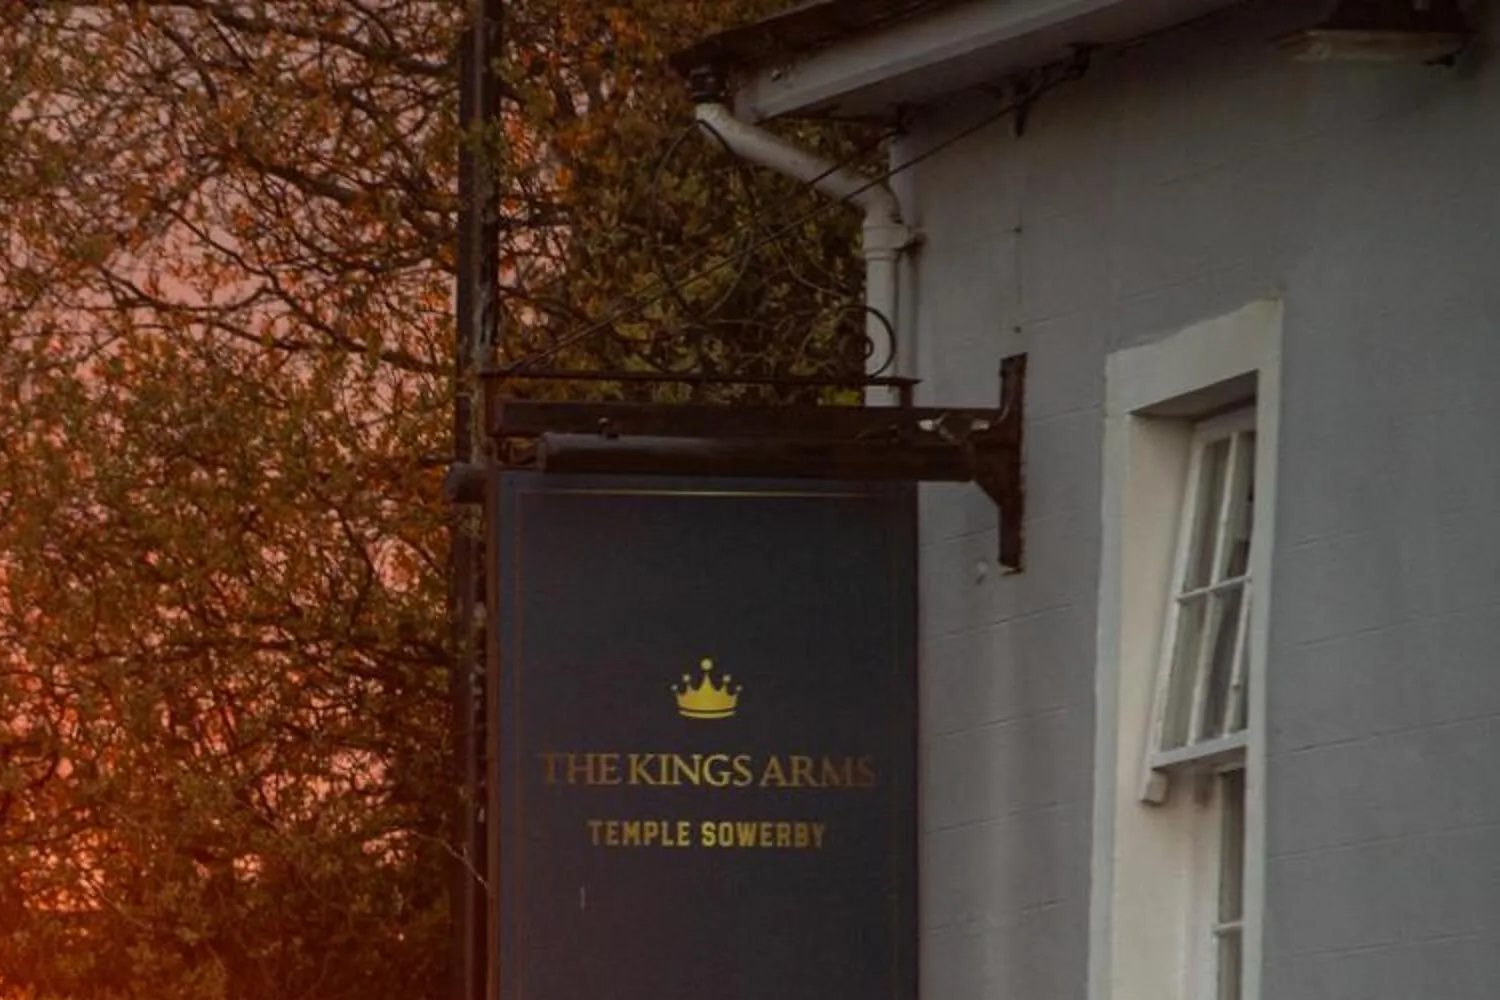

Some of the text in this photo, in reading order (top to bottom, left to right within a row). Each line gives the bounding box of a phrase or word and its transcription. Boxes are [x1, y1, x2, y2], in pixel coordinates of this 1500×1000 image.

[539, 753, 876, 788] THE KINGS ARMS
[588, 821, 826, 848] TEMPLE SOWERBY
